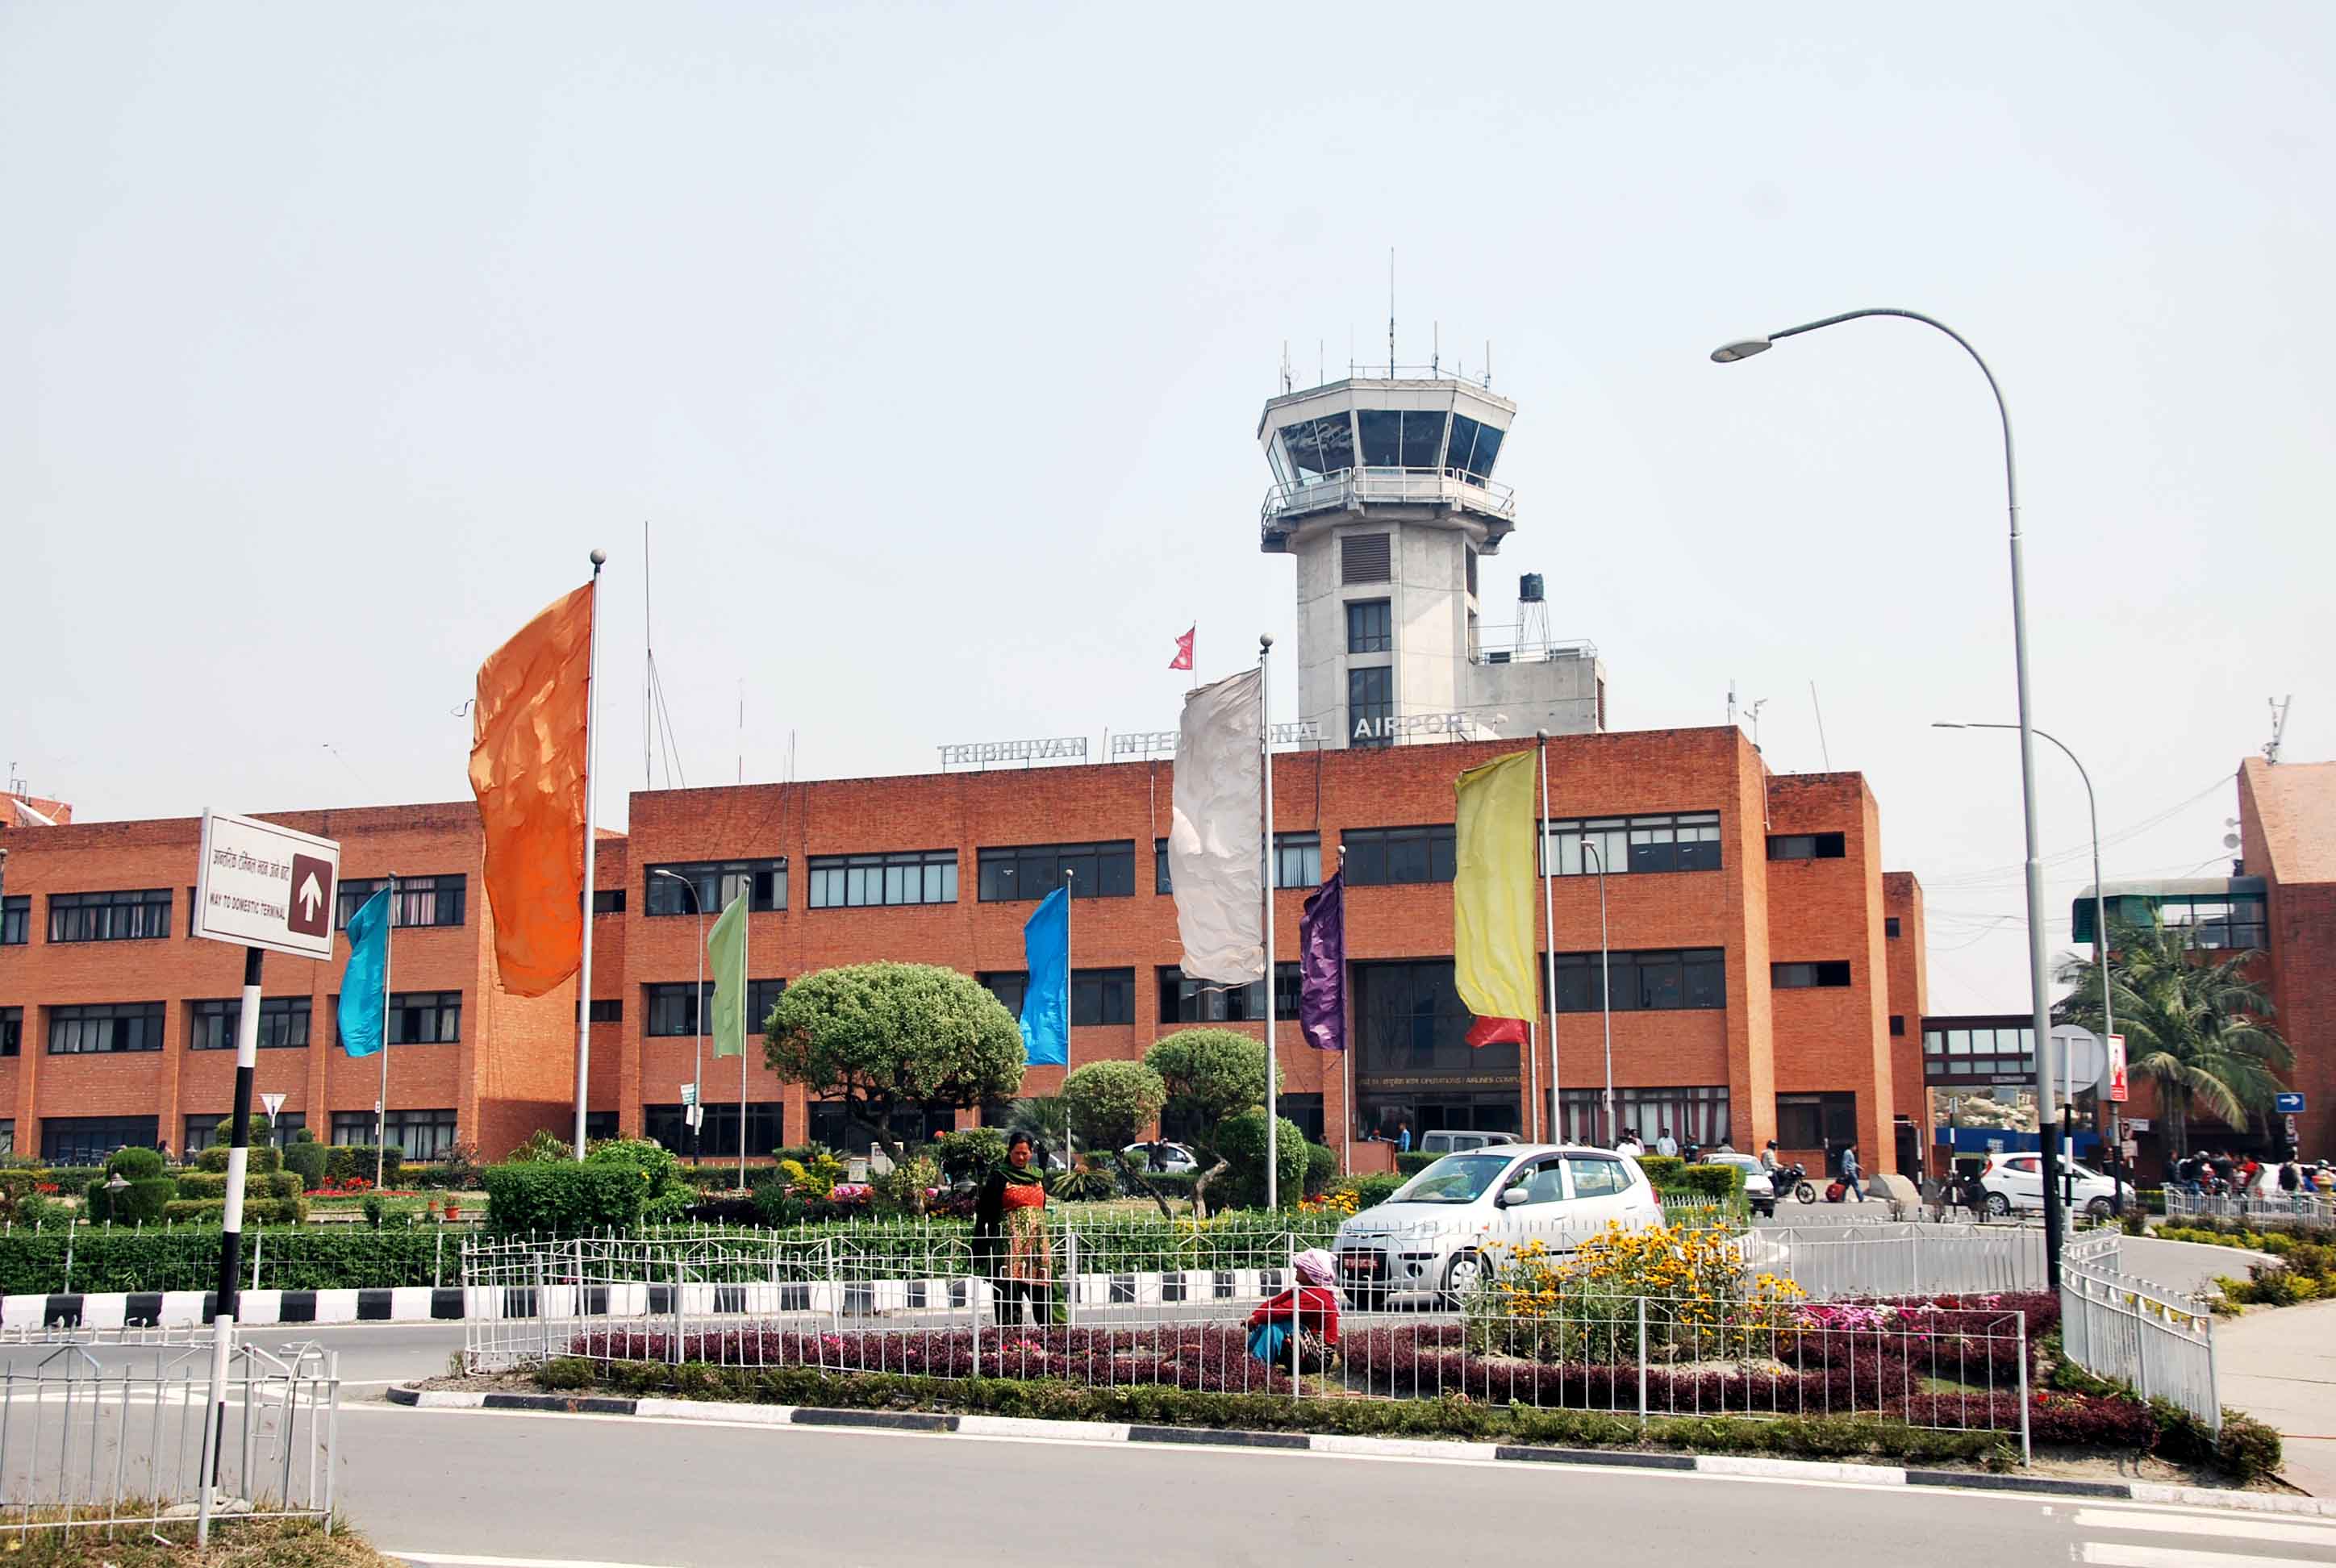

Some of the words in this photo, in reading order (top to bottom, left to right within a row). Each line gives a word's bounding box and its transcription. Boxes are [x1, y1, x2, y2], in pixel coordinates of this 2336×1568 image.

[936, 737, 1087, 763] TRIBHUVAN
[1354, 711, 1483, 738] AIRPORT
[210, 893, 222, 904] WAY
[223, 895, 231, 908] TO
[232, 897, 259, 913] DOMESTIC
[261, 903, 285, 920] TERMINAL
